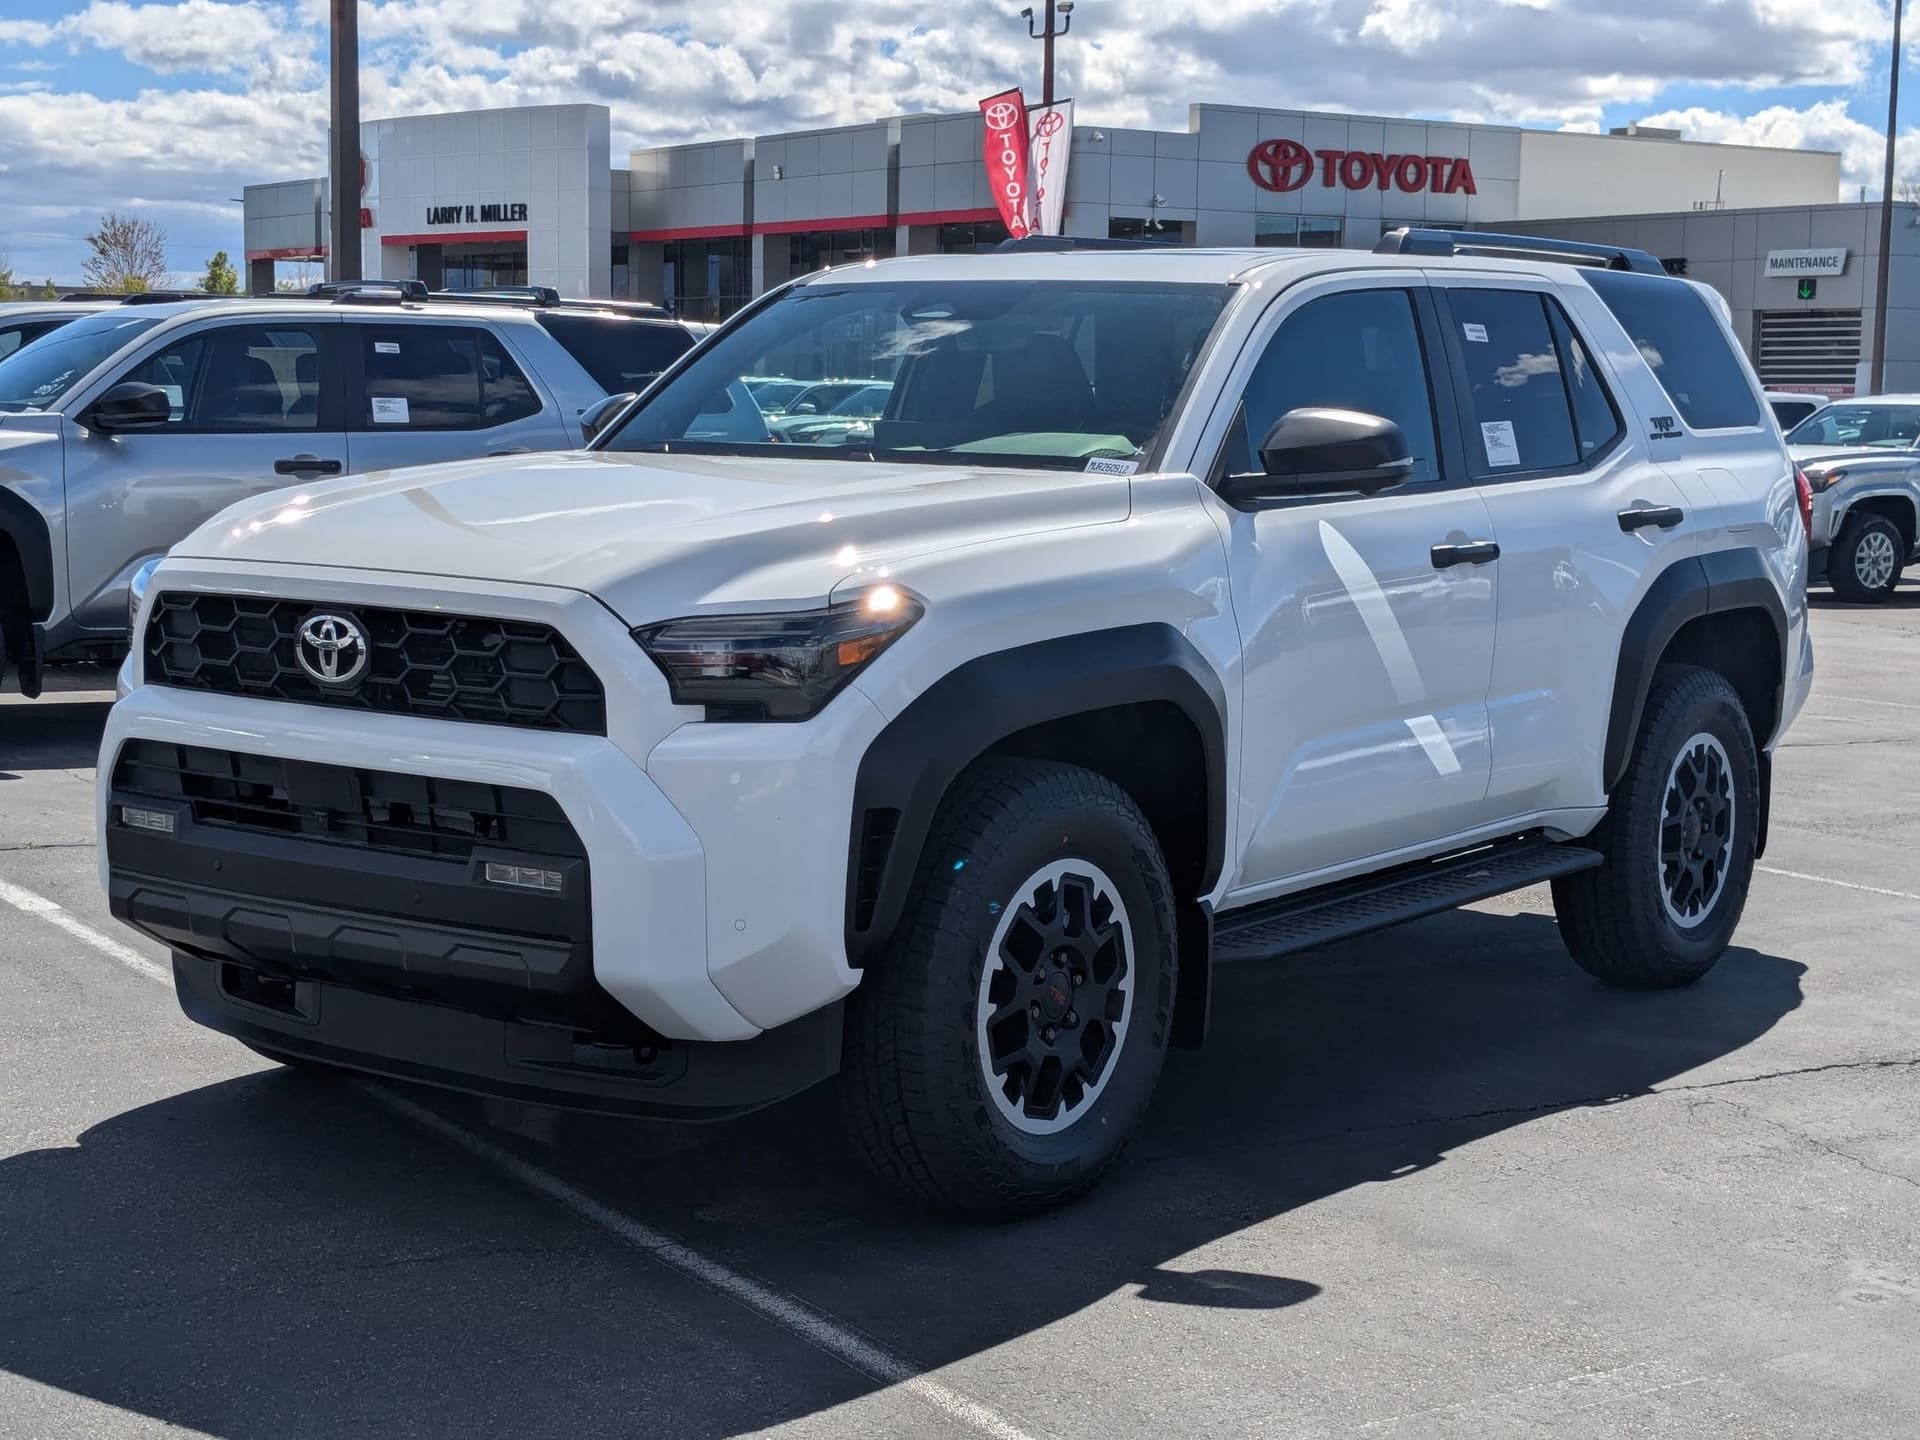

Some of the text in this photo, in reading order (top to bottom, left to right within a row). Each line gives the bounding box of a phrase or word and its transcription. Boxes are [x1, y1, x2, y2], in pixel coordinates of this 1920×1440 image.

[999, 133, 1025, 230] TOYOTA
[1315, 150, 1477, 195] TOYOTA
[426, 203, 527, 225] LARRY H. MILLER
[1769, 256, 1839, 270] MAINTENANCE
